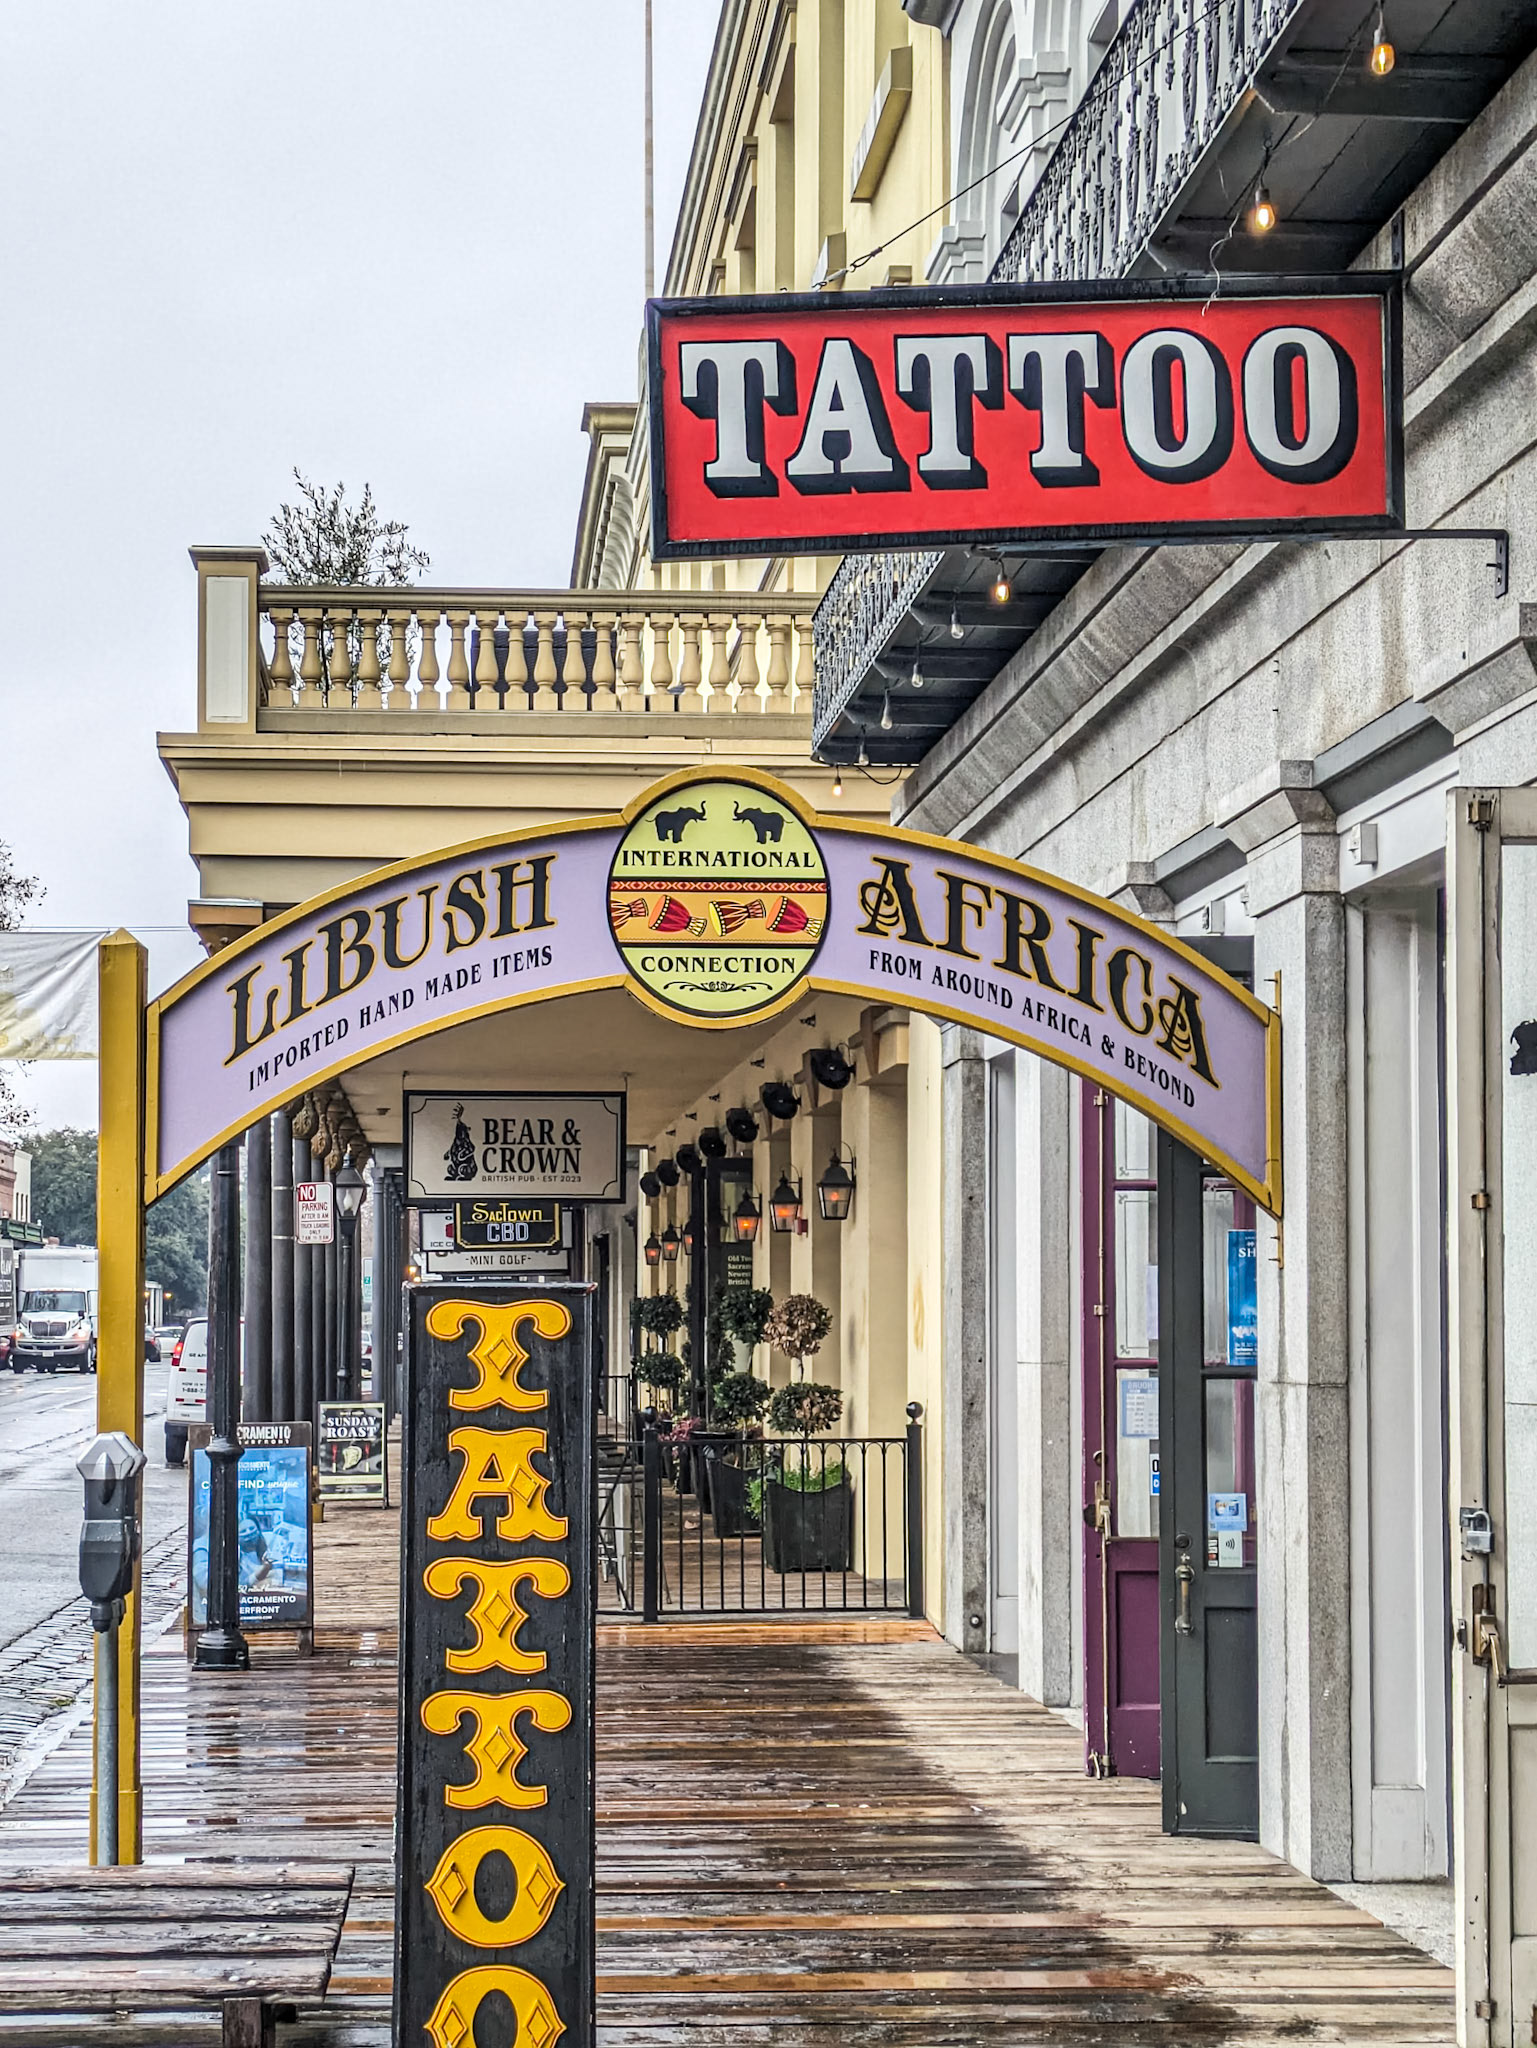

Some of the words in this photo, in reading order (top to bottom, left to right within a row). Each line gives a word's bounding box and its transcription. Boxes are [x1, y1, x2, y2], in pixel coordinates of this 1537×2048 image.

[679, 326, 1358, 499] TATTOO
[622, 850, 816, 868] INTERNATIONAL
[224, 853, 558, 1067] LIBUSH
[640, 956, 796, 974] CONNECTION
[856, 854, 1222, 1090] AFRICA
[249, 1018, 349, 1092] IMPORTED
[359, 989, 415, 1029] HAND
[425, 963, 482, 1001] MADE
[492, 945, 553, 979] ITEMS
[869, 949, 923, 981] FROM
[931, 966, 1013, 1009] AROUND
[1021, 997, 1092, 1047] AFRICA
[1100, 1034, 1115, 1059] &
[1124, 1046, 1196, 1109] BEYOND
[482, 1118, 555, 1145] BEAR
[561, 1118, 581, 1145] &
[482, 1147, 582, 1174] CROWN
[482, 1175, 515, 1183] BRITISH
[518, 1175, 535, 1183] PUB
[543, 1175, 558, 1183] EST
[560, 1175, 582, 1183] 2023
[300, 1186, 316, 1200] NO
[302, 1202, 328, 1211] PARKING
[486, 1222, 529, 1242] CBD
[327, 1416, 376, 1427] SUNDAY
[237, 1425, 292, 1440] CRAMENTO
[327, 1427, 377, 1438] ROAST
[238, 1480, 264, 1489] FIND
[239, 1595, 297, 1604] ACRAMENTO
[239, 1606, 280, 1615] ERFRONT
[420, 1299, 573, 2048] TATTOO
